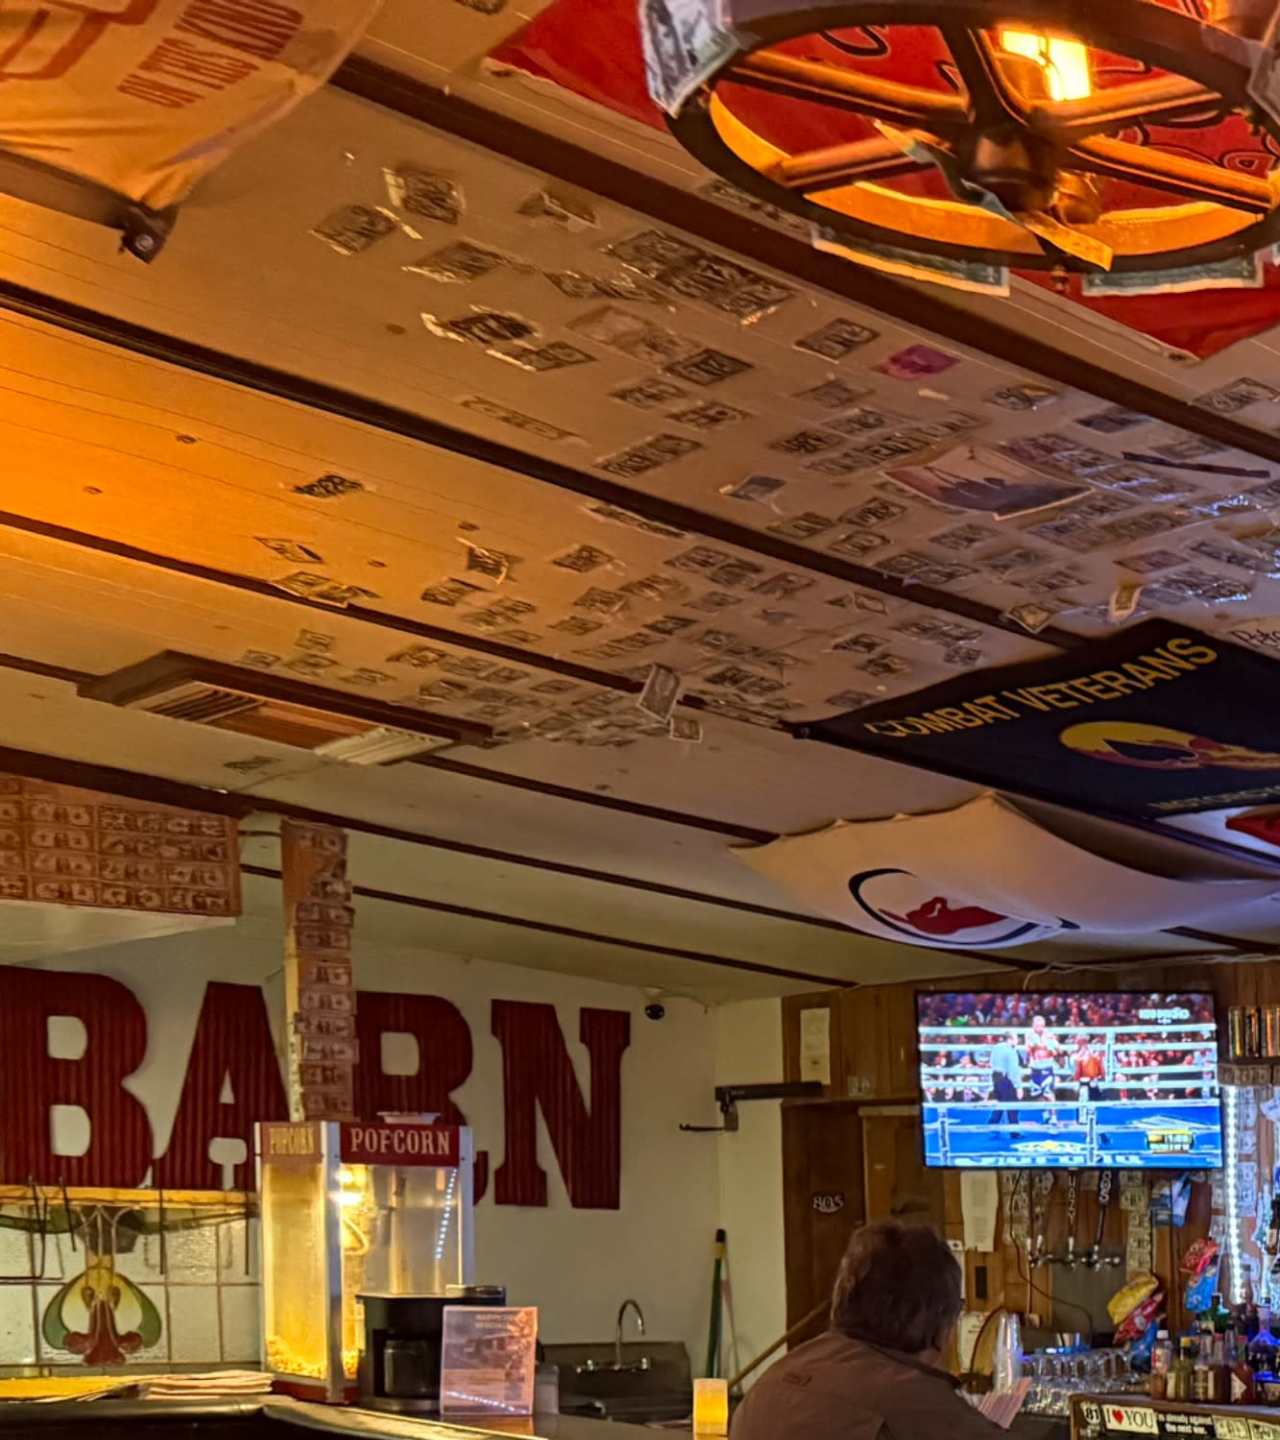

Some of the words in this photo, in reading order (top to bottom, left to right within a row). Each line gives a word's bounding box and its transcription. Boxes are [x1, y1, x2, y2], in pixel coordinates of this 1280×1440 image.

[864, 694, 1022, 738] COMBAT
[1002, 637, 1218, 714] VETERANS
[0, 965, 631, 1210] BARN
[350, 1126, 452, 1156] POPCORN
[1125, 1410, 1154, 1428] YOU
